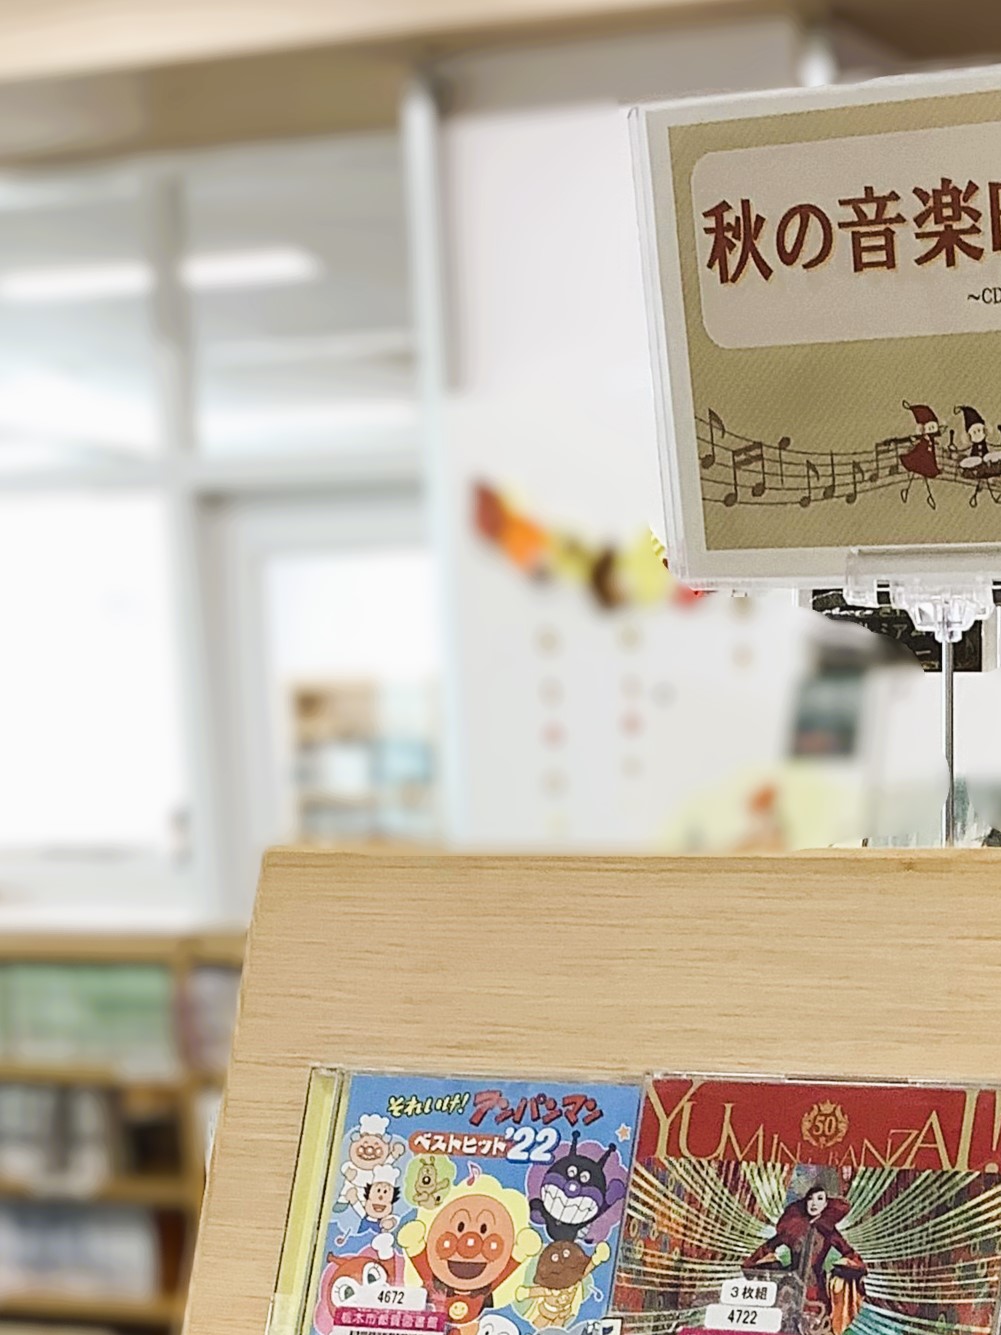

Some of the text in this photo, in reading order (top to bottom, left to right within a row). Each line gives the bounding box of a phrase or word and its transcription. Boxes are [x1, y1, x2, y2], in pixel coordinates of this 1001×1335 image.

[645, 1078, 812, 1165] YUMIN
[813, 1115, 838, 1137] 50
[377, 1290, 405, 1305] 4672
[729, 1285, 768, 1301] 3枚組
[727, 1309, 758, 1325] 4722
